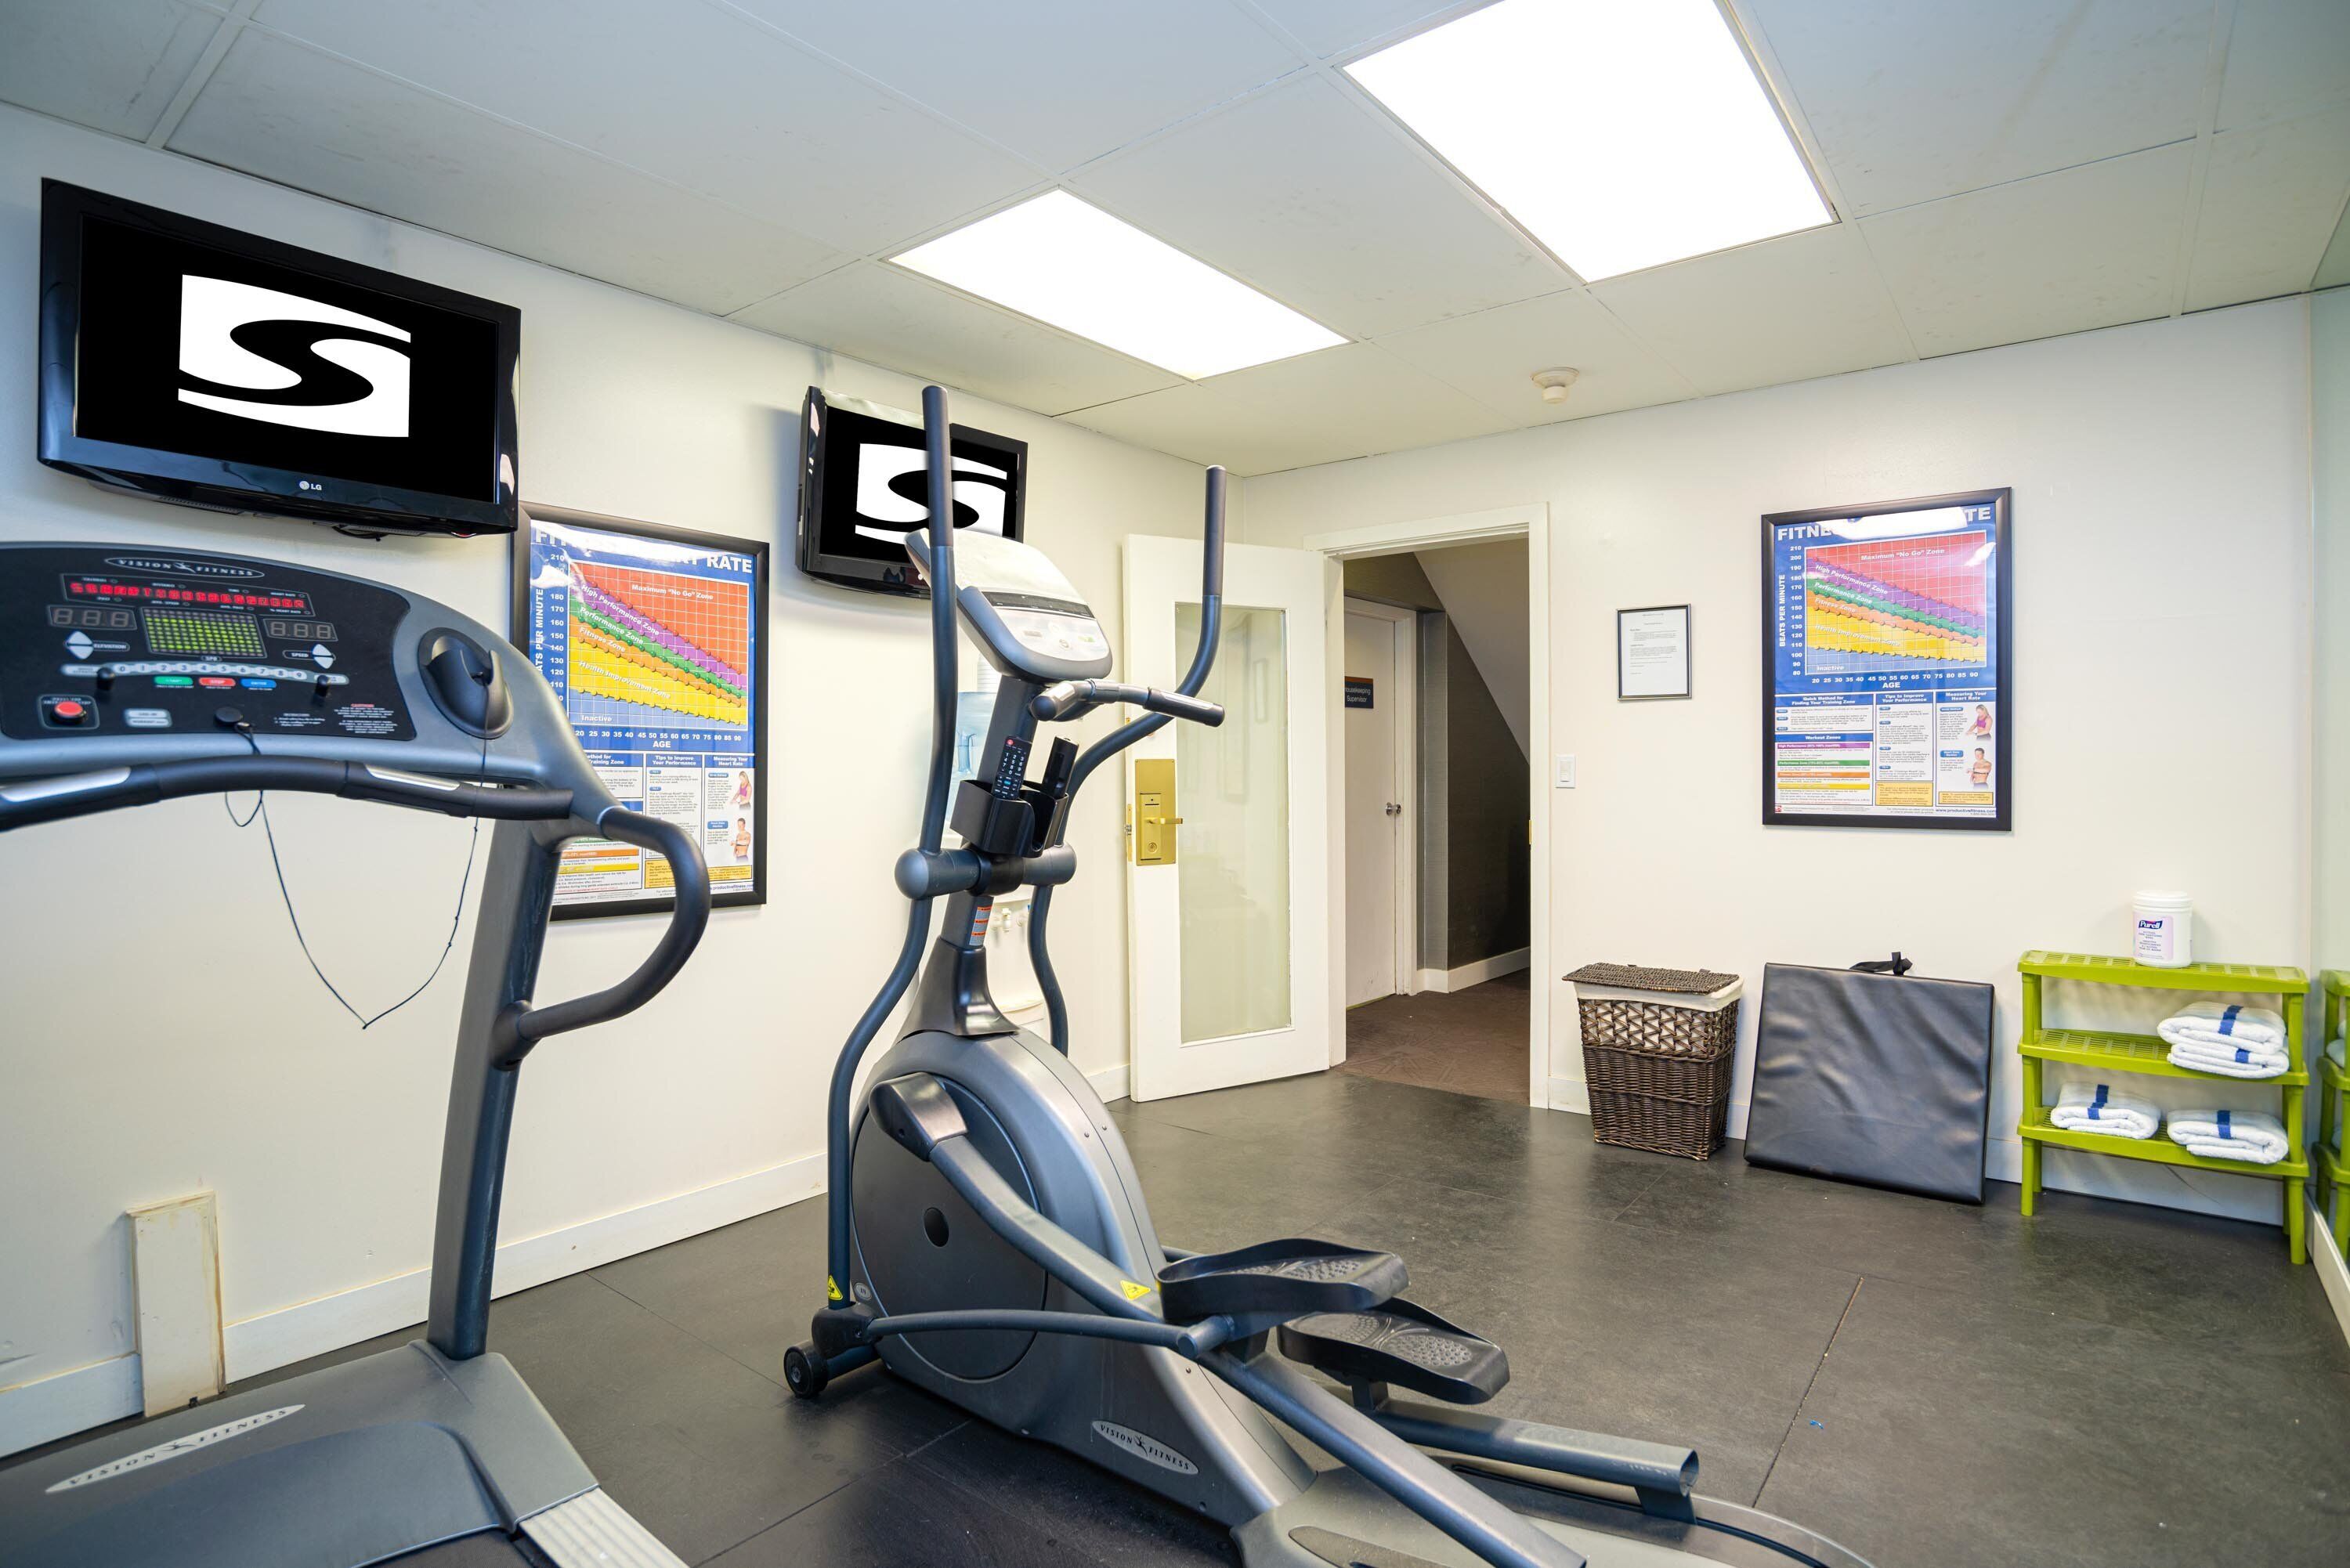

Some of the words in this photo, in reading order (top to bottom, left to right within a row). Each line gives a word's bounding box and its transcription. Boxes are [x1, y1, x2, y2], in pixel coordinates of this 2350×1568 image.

[1778, 525, 1831, 540] FITNE
[118, 559, 172, 569] VISION
[197, 566, 253, 576] FITNESS
[707, 554, 752, 573] RATE
[631, 584, 667, 594] Maximum
[1816, 565, 1830, 574] High
[1831, 569, 1871, 588] Performance
[1871, 584, 1888, 594] Zone
[1815, 582, 1855, 598] Performance
[1856, 594, 1873, 604] Zone
[581, 584, 598, 598] High
[599, 596, 642, 625] Performance
[642, 622, 660, 635] Zone
[1815, 598, 1839, 608] Fitness
[1840, 604, 1856, 612] Zone
[580, 607, 624, 634] Performance
[626, 631, 644, 644] Zone
[580, 627, 606, 643] Fitness
[608, 639, 625, 652] Zone
[2139, 920, 2161, 929] Purell
[69, 1453, 155, 1484] VISION
[200, 1410, 287, 1443] FITNESS
[1101, 1424, 1133, 1444] VISION
[1149, 1447, 1190, 1470] FITNESS
